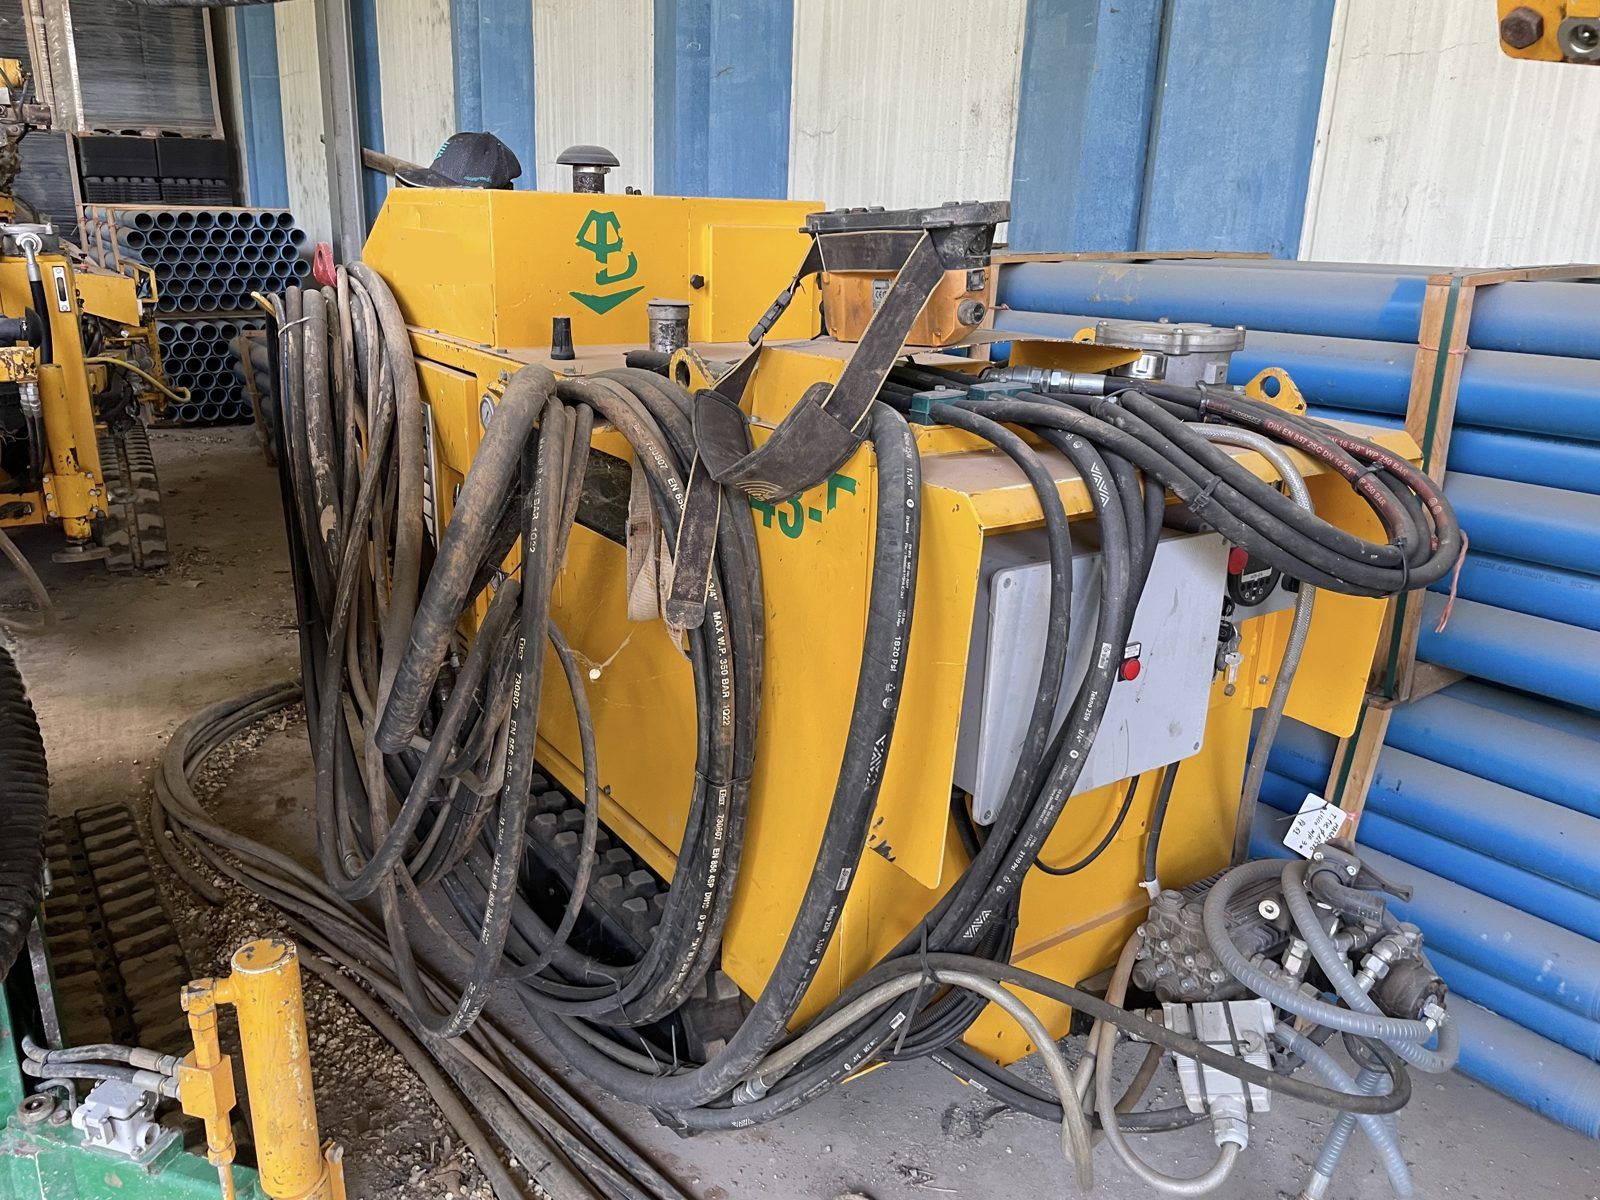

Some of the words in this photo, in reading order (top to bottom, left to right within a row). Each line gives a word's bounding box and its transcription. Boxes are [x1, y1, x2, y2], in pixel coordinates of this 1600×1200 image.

[1267, 421, 1281, 432] DIN
[1281, 428, 1294, 438] EN
[1293, 433, 1308, 444] 857
[1307, 439, 1323, 454] 2SC
[1322, 449, 1335, 460] DN
[1334, 458, 1342, 467] 16
[1364, 482, 1376, 495] 250
[1373, 492, 1386, 506] BAR
[1339, 440, 1348, 448] 16
[1365, 449, 1380, 460] WP
[1379, 456, 1393, 466] 250
[1392, 463, 1409, 477] BAR
[667, 478, 680, 492] EN
[532, 498, 541, 520] BAR
[712, 610, 724, 634] MAX
[717, 636, 727, 657] W.P.
[892, 636, 902, 658] 1820
[720, 658, 729, 676] 350
[722, 678, 730, 698] BAR
[1087, 690, 1098, 708] Tekno
[510, 720, 517, 736] EN
[711, 848, 721, 859] EN
[706, 874, 716, 888] 4SP
